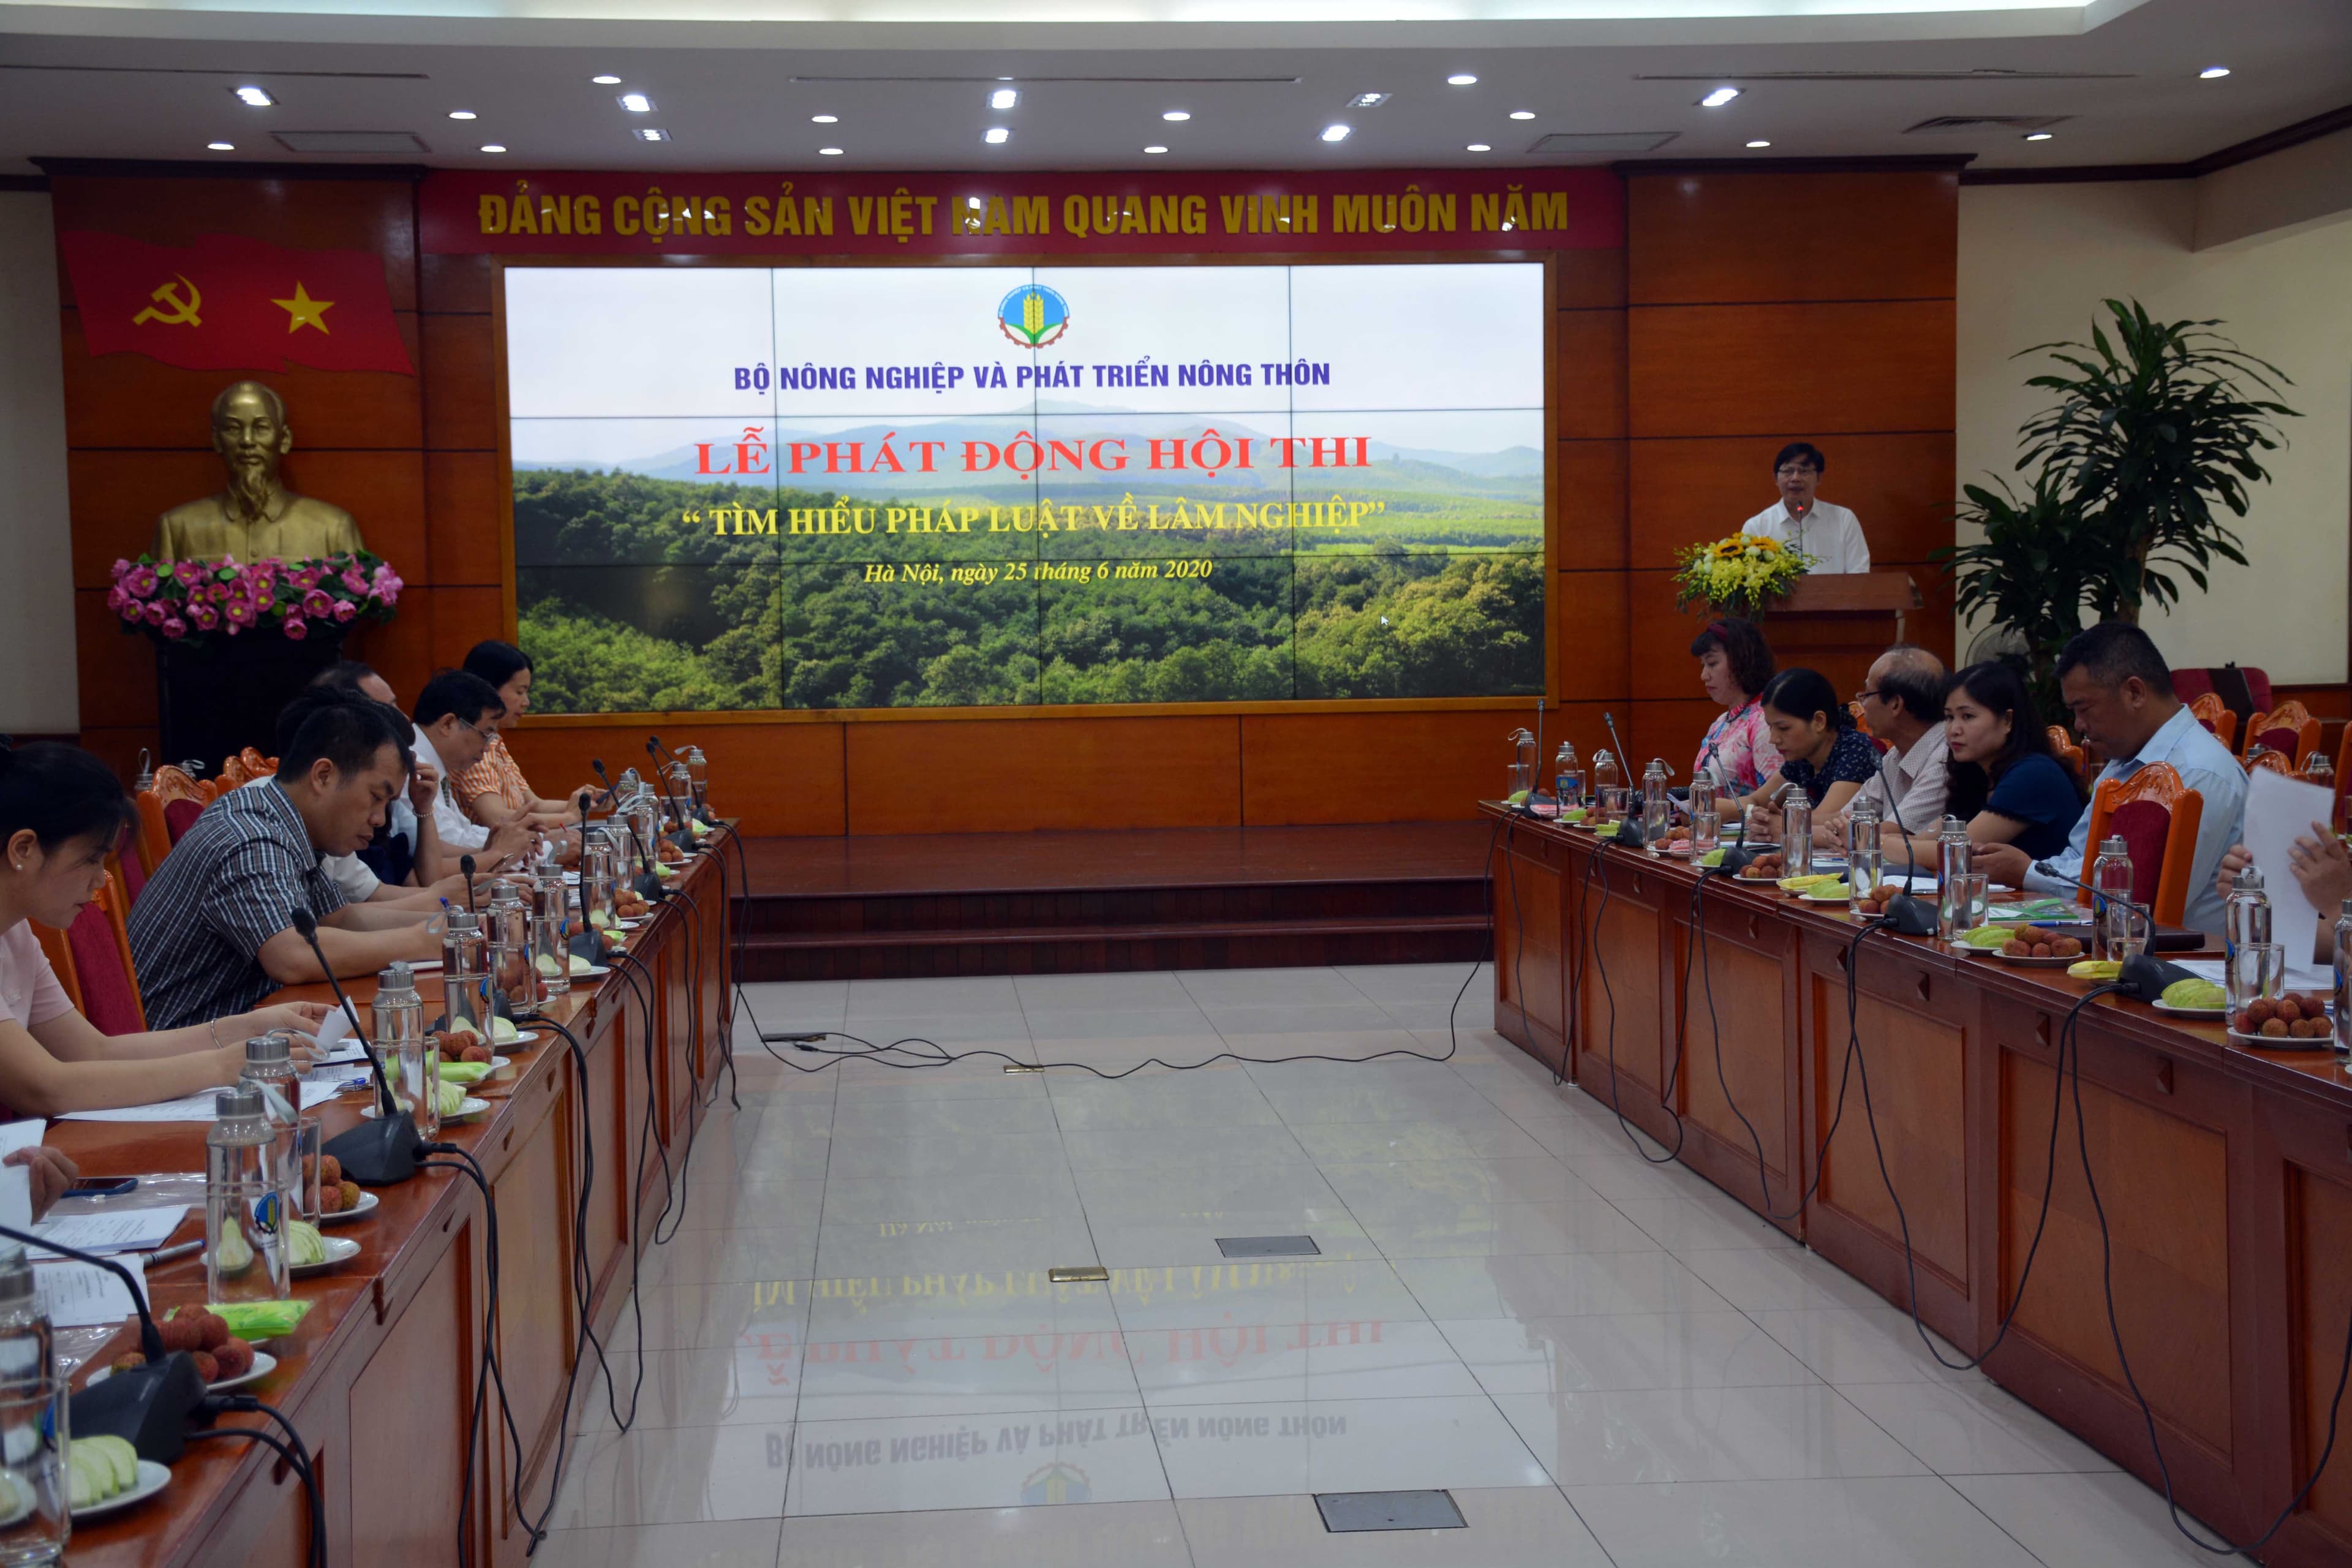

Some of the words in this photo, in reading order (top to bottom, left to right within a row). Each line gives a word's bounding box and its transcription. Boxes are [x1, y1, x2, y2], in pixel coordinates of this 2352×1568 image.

[479, 180, 601, 235] ĐẢNG
[614, 187, 731, 243] CỘNG
[745, 181, 834, 236] SẢN
[848, 188, 938, 243] VIỆT
[952, 196, 1050, 235] NAM
[1064, 195, 1207, 238] QUANG
[1220, 195, 1318, 235] VINH
[1333, 184, 1457, 233] MUÔN
[1471, 184, 1568, 232] NĂM
[735, 363, 770, 394] BỘ
[781, 363, 856, 390] NÔNG
[866, 362, 964, 393] NGHIỆP
[974, 361, 1008, 388] VÀ
[1017, 361, 1084, 388] PHÁT
[1093, 355, 1169, 387] TRIỂN
[1178, 360, 1251, 386] NÔNG
[1261, 358, 1330, 386] THÔN
[694, 426, 771, 475] LỄ
[786, 431, 945, 474] PHÁT
[960, 430, 1131, 480] ĐỘNG
[1147, 428, 1254, 478] HỘI
[1270, 437, 1372, 468] THI
[788, 496, 876, 535] HIỂU
[886, 500, 982, 533] PHÁP
[989, 499, 1084, 538] LUẬT
[1093, 492, 1140, 530] VỀ
[1148, 497, 1226, 530] LÂM
[864, 564, 895, 583] Hà
[902, 564, 944, 585] Nội,
[951, 564, 998, 586] ngày
[1005, 562, 1027, 581] 25
[1034, 562, 1091, 584] tháng
[1097, 562, 1109, 579] 6
[1115, 562, 1158, 579] năm
[1164, 560, 1213, 578] 2020
